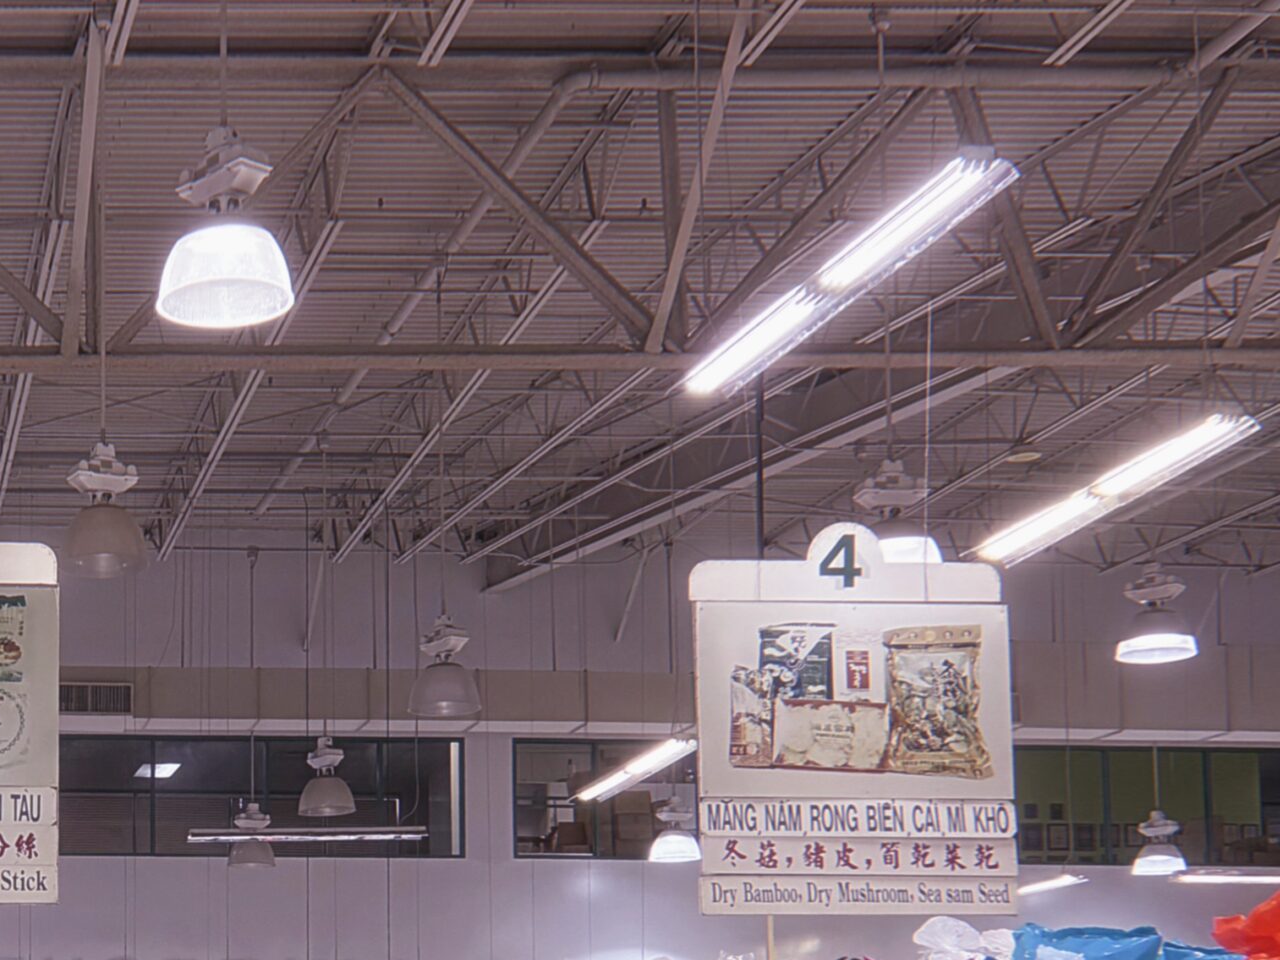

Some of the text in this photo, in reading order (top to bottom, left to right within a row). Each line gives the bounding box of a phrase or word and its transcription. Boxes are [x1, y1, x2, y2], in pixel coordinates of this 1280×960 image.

[819, 533, 862, 588] 4
[810, 803, 859, 833] RONG
[0, 870, 48, 893] Stick
[711, 881, 737, 908] Dry
[807, 882, 833, 908] Dry
[917, 882, 943, 904] Sea
[946, 888, 974, 905] sam
[977, 883, 1010, 905] Seed
